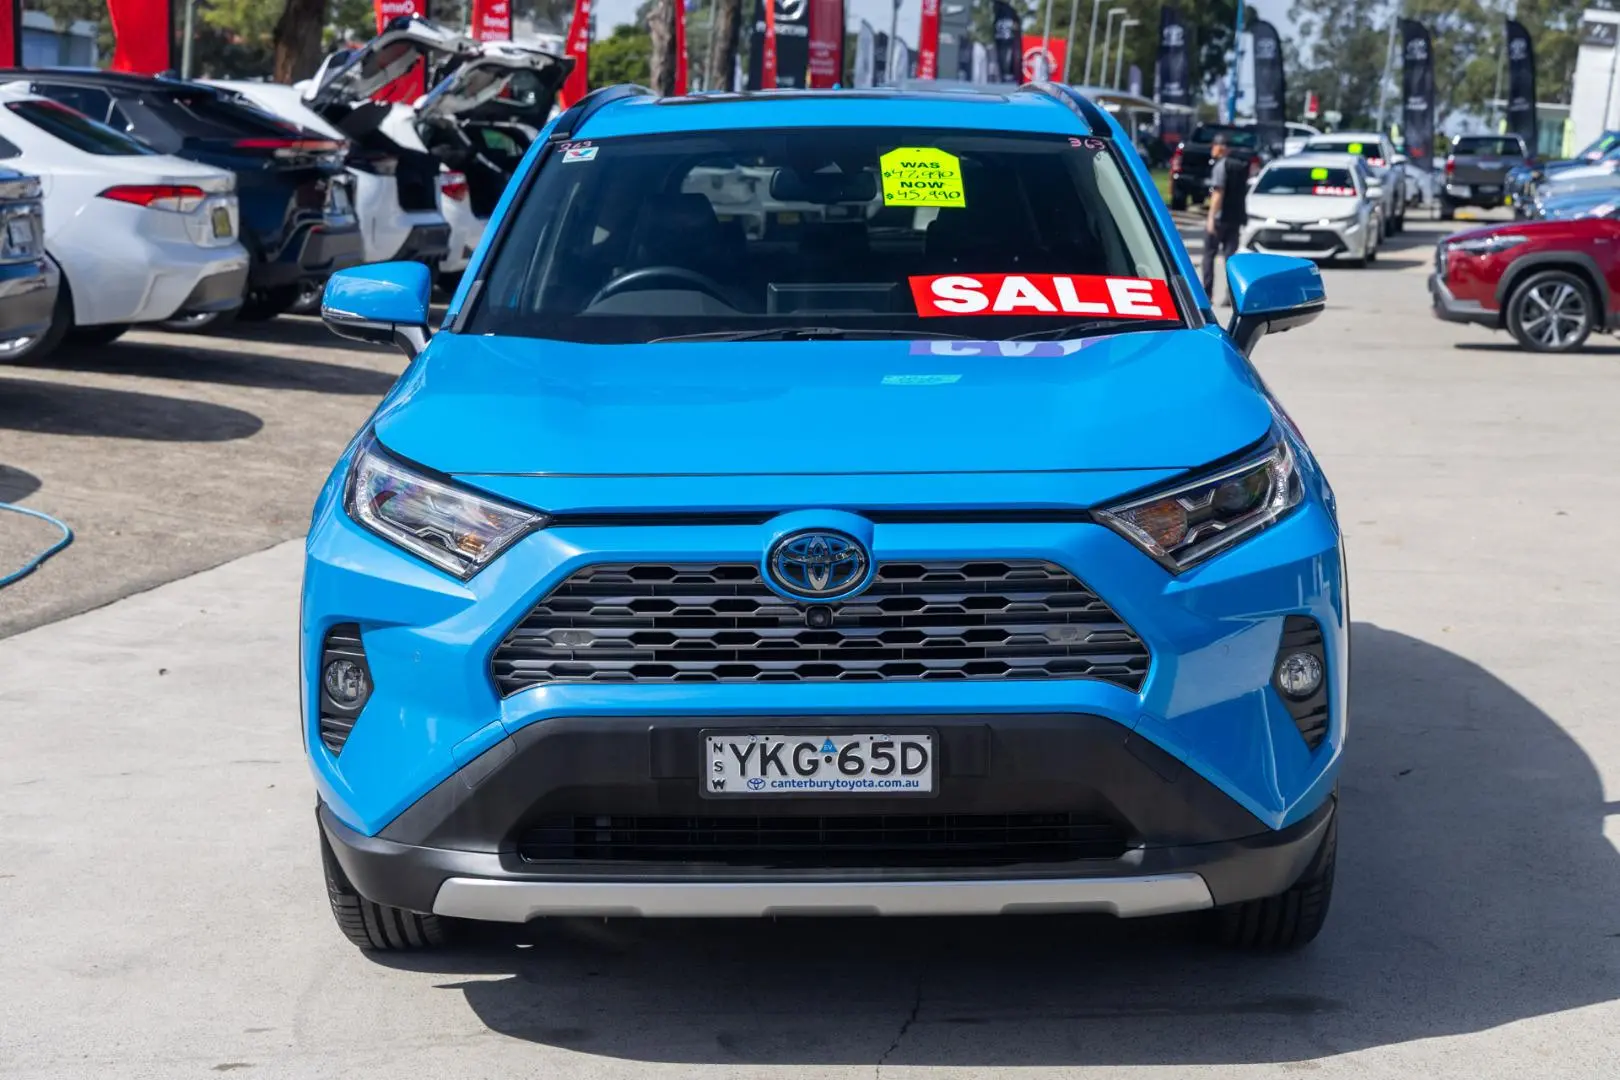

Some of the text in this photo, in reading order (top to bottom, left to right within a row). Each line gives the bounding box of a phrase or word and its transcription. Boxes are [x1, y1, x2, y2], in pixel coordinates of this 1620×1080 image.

[900, 181, 944, 189] NOW
[931, 276, 1162, 316] SALE
[771, 777, 919, 790] canterburytoyota.com.au
